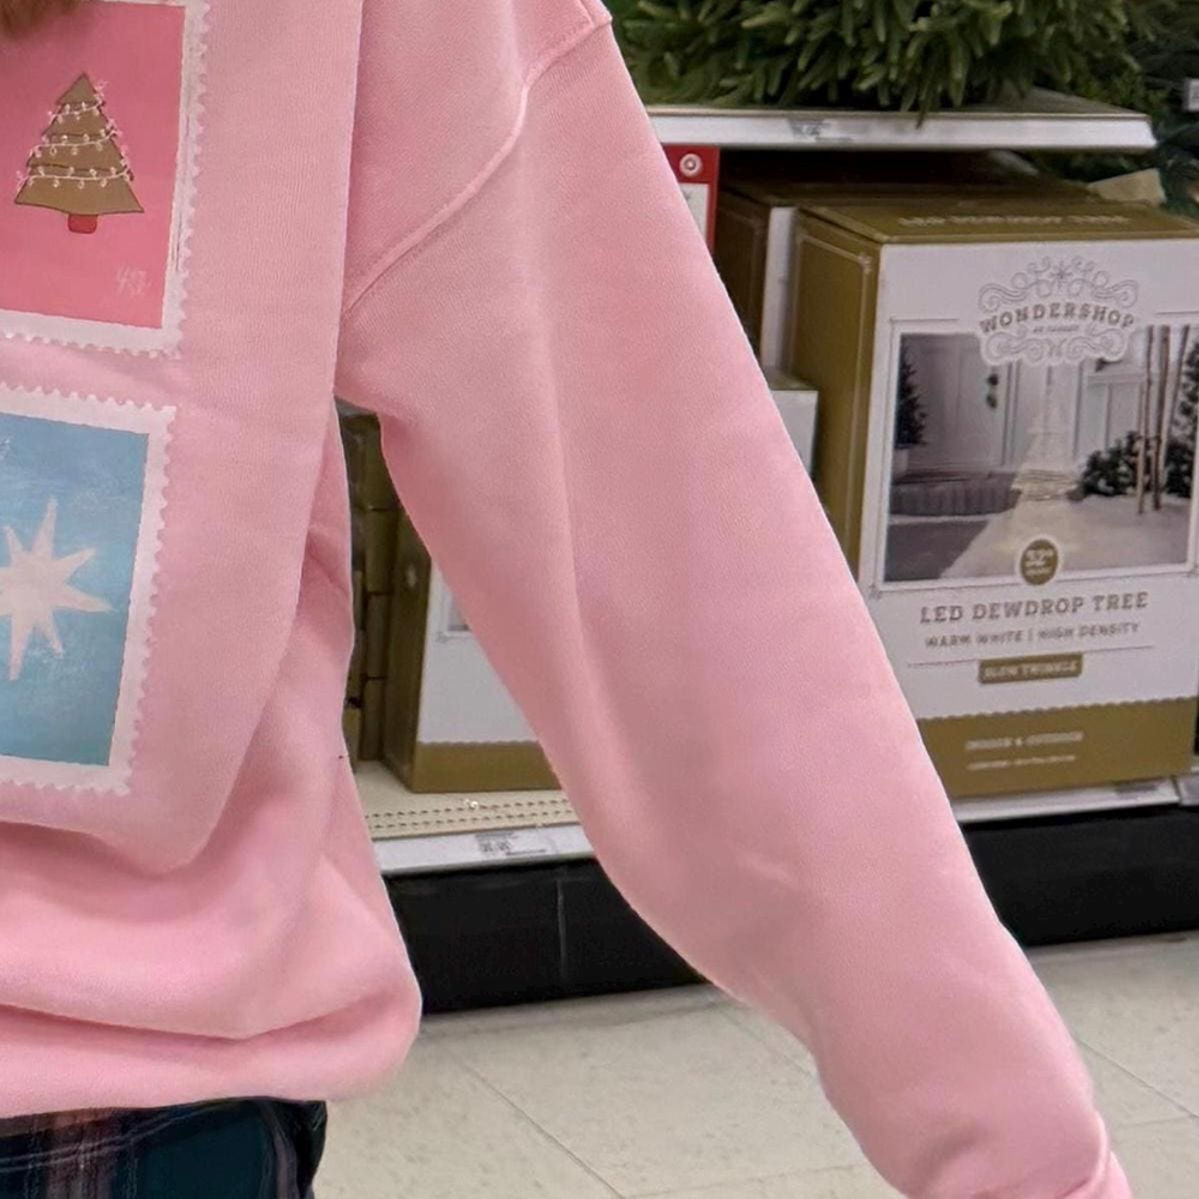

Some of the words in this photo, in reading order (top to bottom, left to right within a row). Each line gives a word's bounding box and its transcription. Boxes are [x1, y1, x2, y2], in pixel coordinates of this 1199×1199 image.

[980, 302, 1135, 333] WONDERSHOP
[920, 605, 963, 623] LED
[972, 597, 1084, 620] DEWDROP
[1092, 591, 1149, 611] TREE
[925, 633, 971, 648] WARM
[977, 630, 1023, 644] WHITE
[1079, 622, 1140, 637] DENSITY
